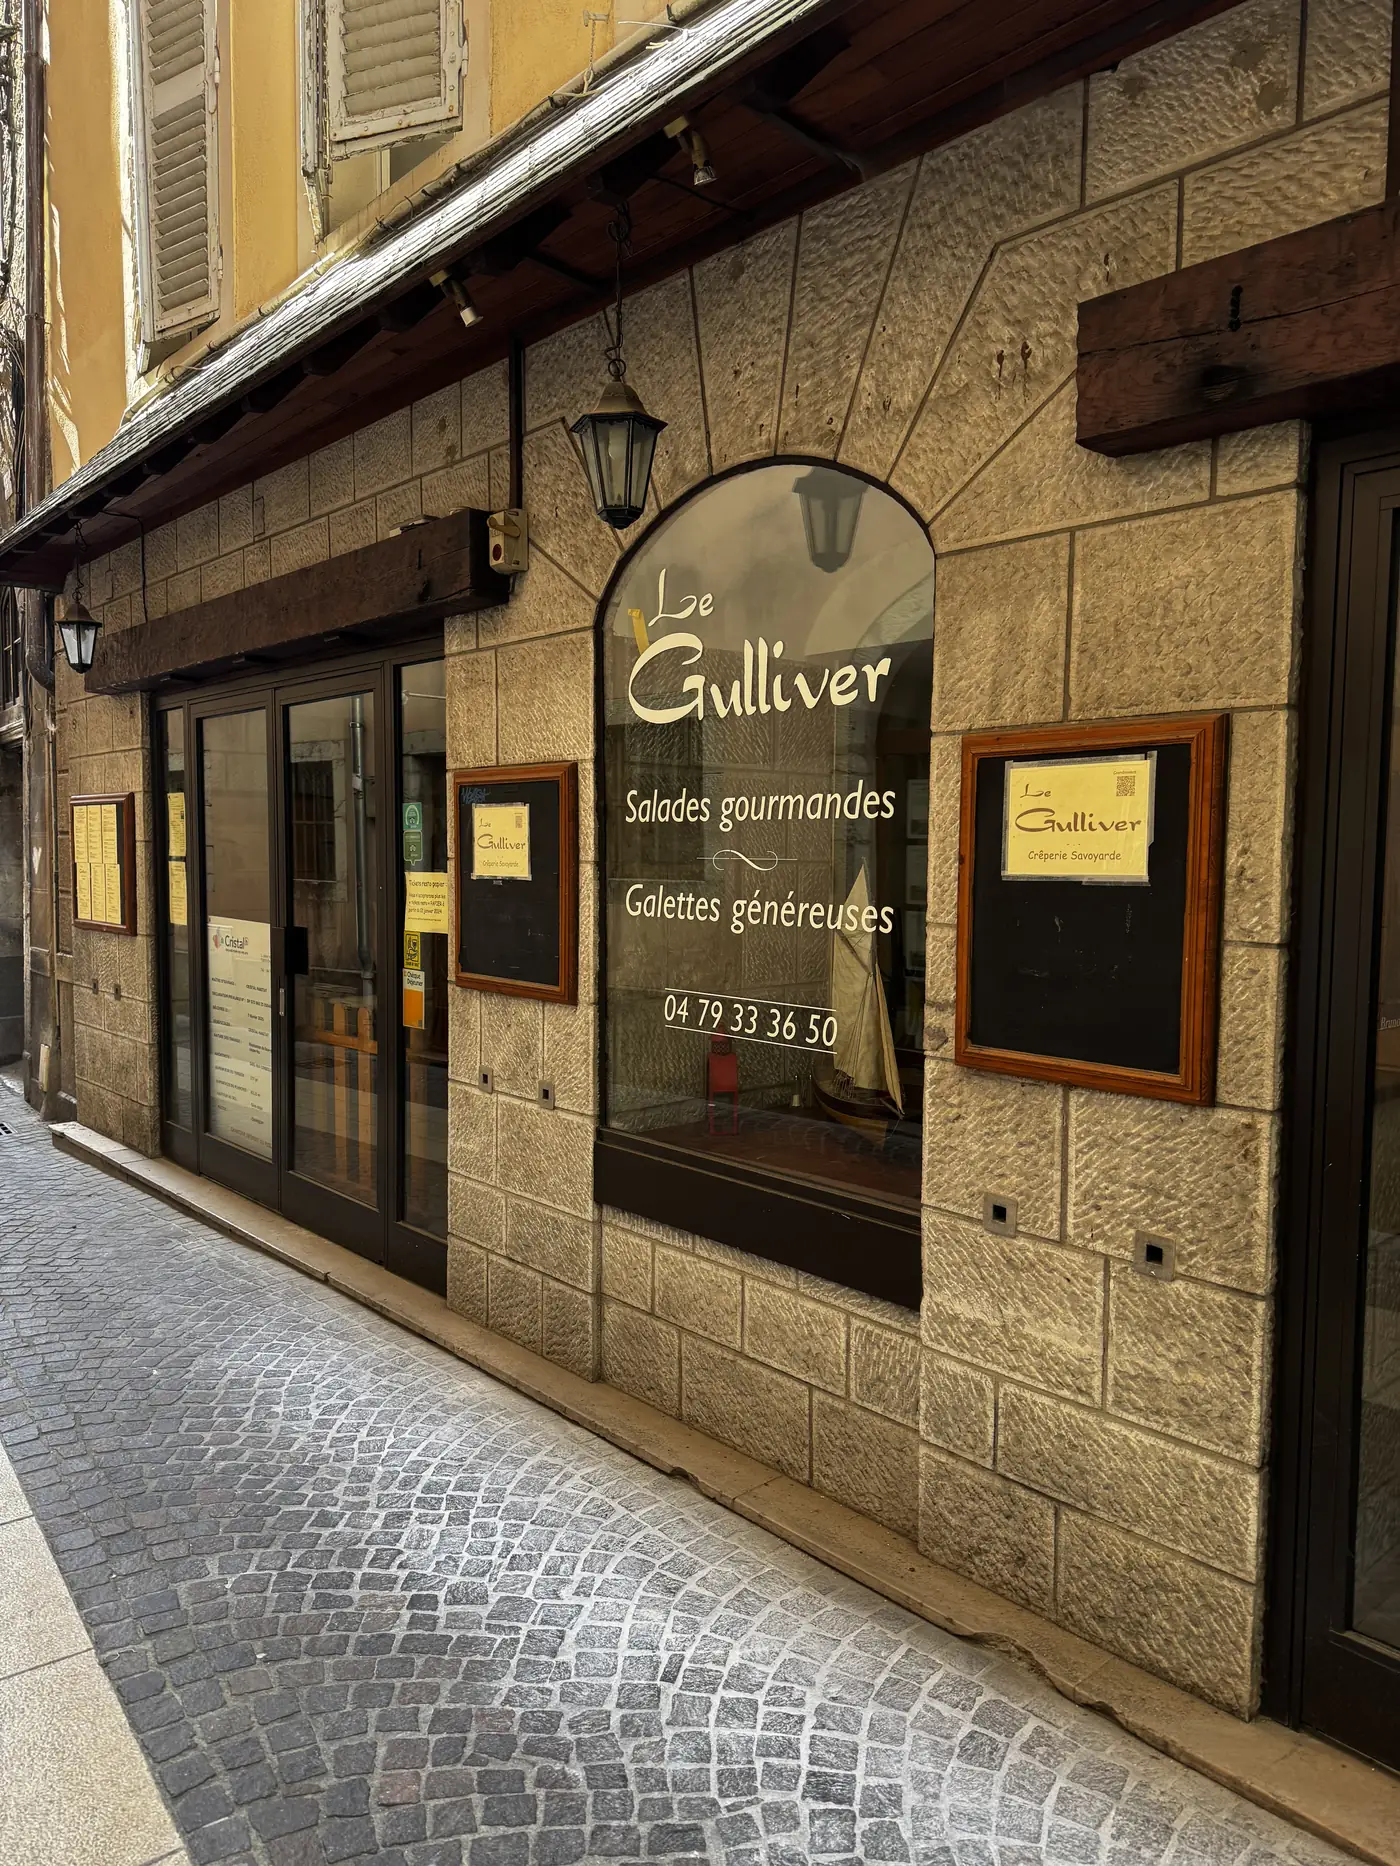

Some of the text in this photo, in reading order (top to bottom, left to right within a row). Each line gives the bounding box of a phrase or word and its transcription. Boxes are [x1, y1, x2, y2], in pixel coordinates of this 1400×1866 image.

[648, 568, 714, 627] Le
[628, 632, 892, 724] Gulliver
[1020, 783, 1051, 798] Le
[625, 779, 896, 832] Salades gourmandes
[478, 818, 491, 828] Le
[1014, 807, 1142, 833] Gulliver
[477, 833, 526, 850] Gulliver
[1028, 850, 1121, 863] Crêperie Savoyarde
[625, 883, 894, 934] Galettes généreuses
[225, 935, 244, 949] Cristal
[664, 994, 838, 1047] 04 79 33 36 50
